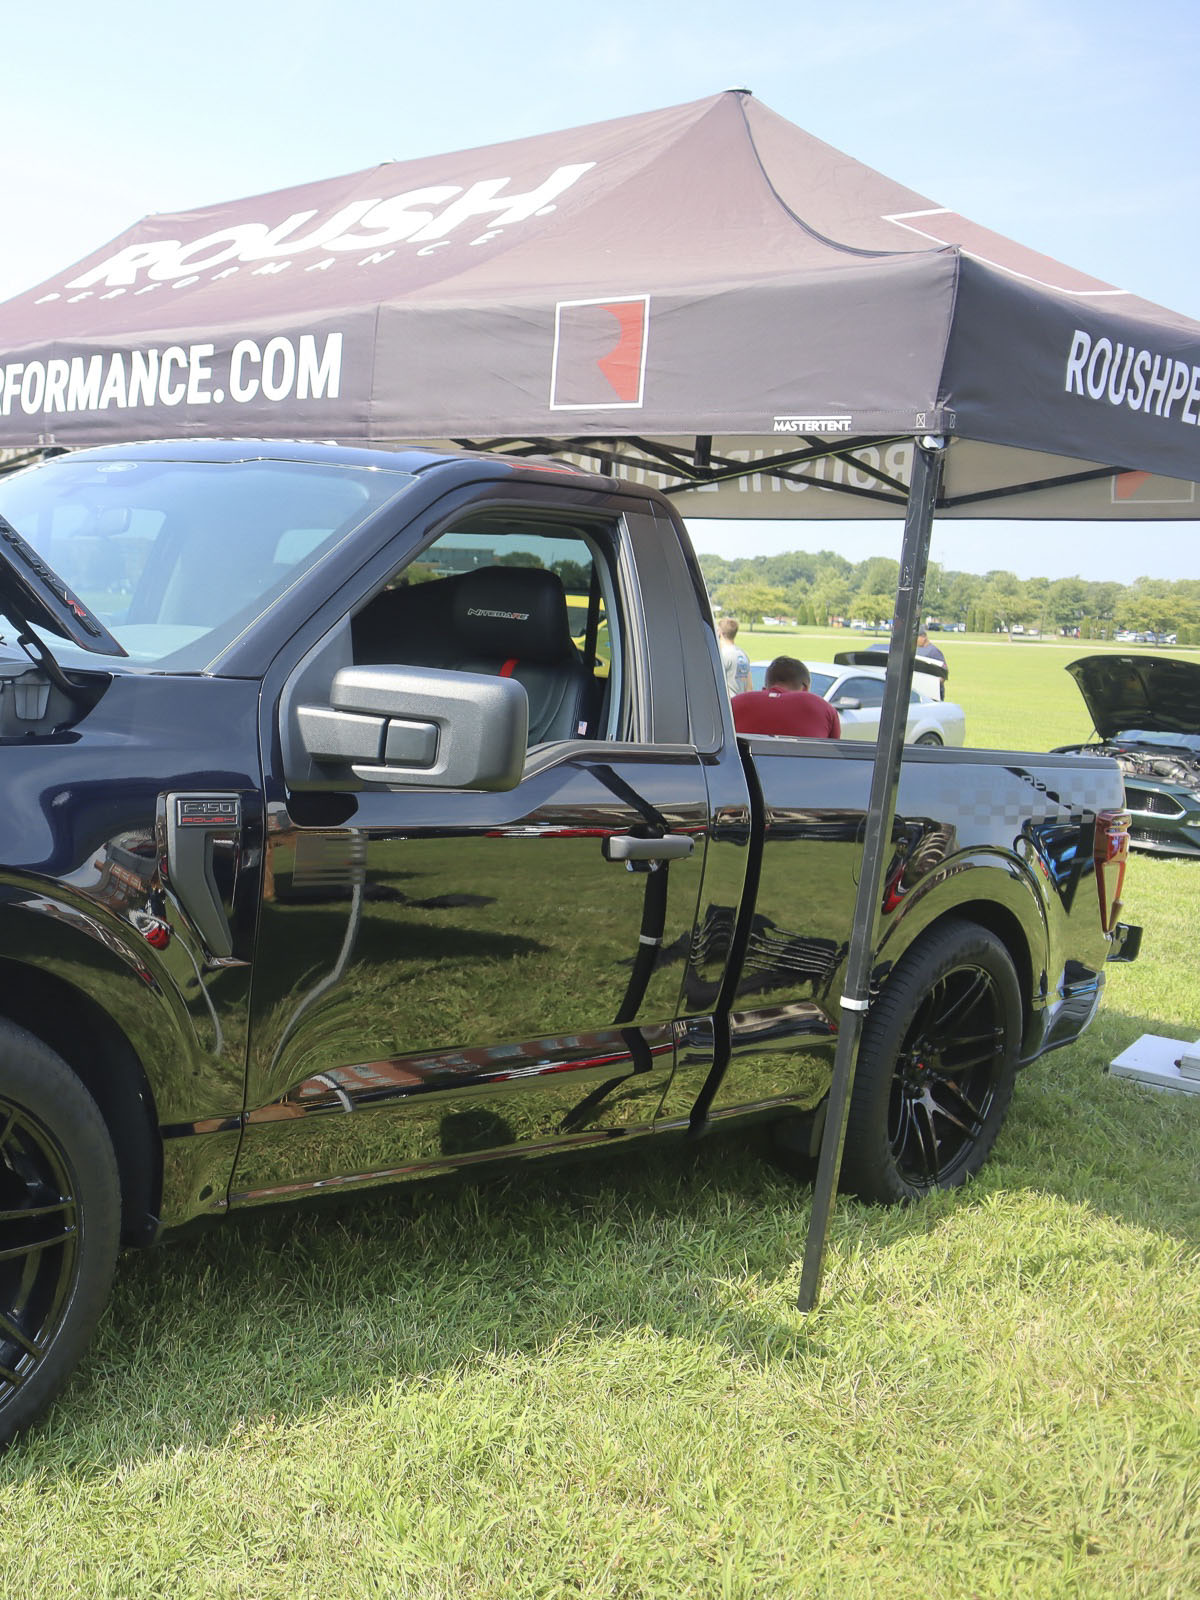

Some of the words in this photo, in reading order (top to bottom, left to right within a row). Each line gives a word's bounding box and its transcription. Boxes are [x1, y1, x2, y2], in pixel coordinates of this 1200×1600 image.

[66, 162, 597, 289] ROUSH
[34, 230, 503, 304] PERFORMANCE
[1065, 329, 1200, 427] ROUSHPE
[773, 420, 852, 432] MASTERTENT
[184, 803, 233, 813] F-150
